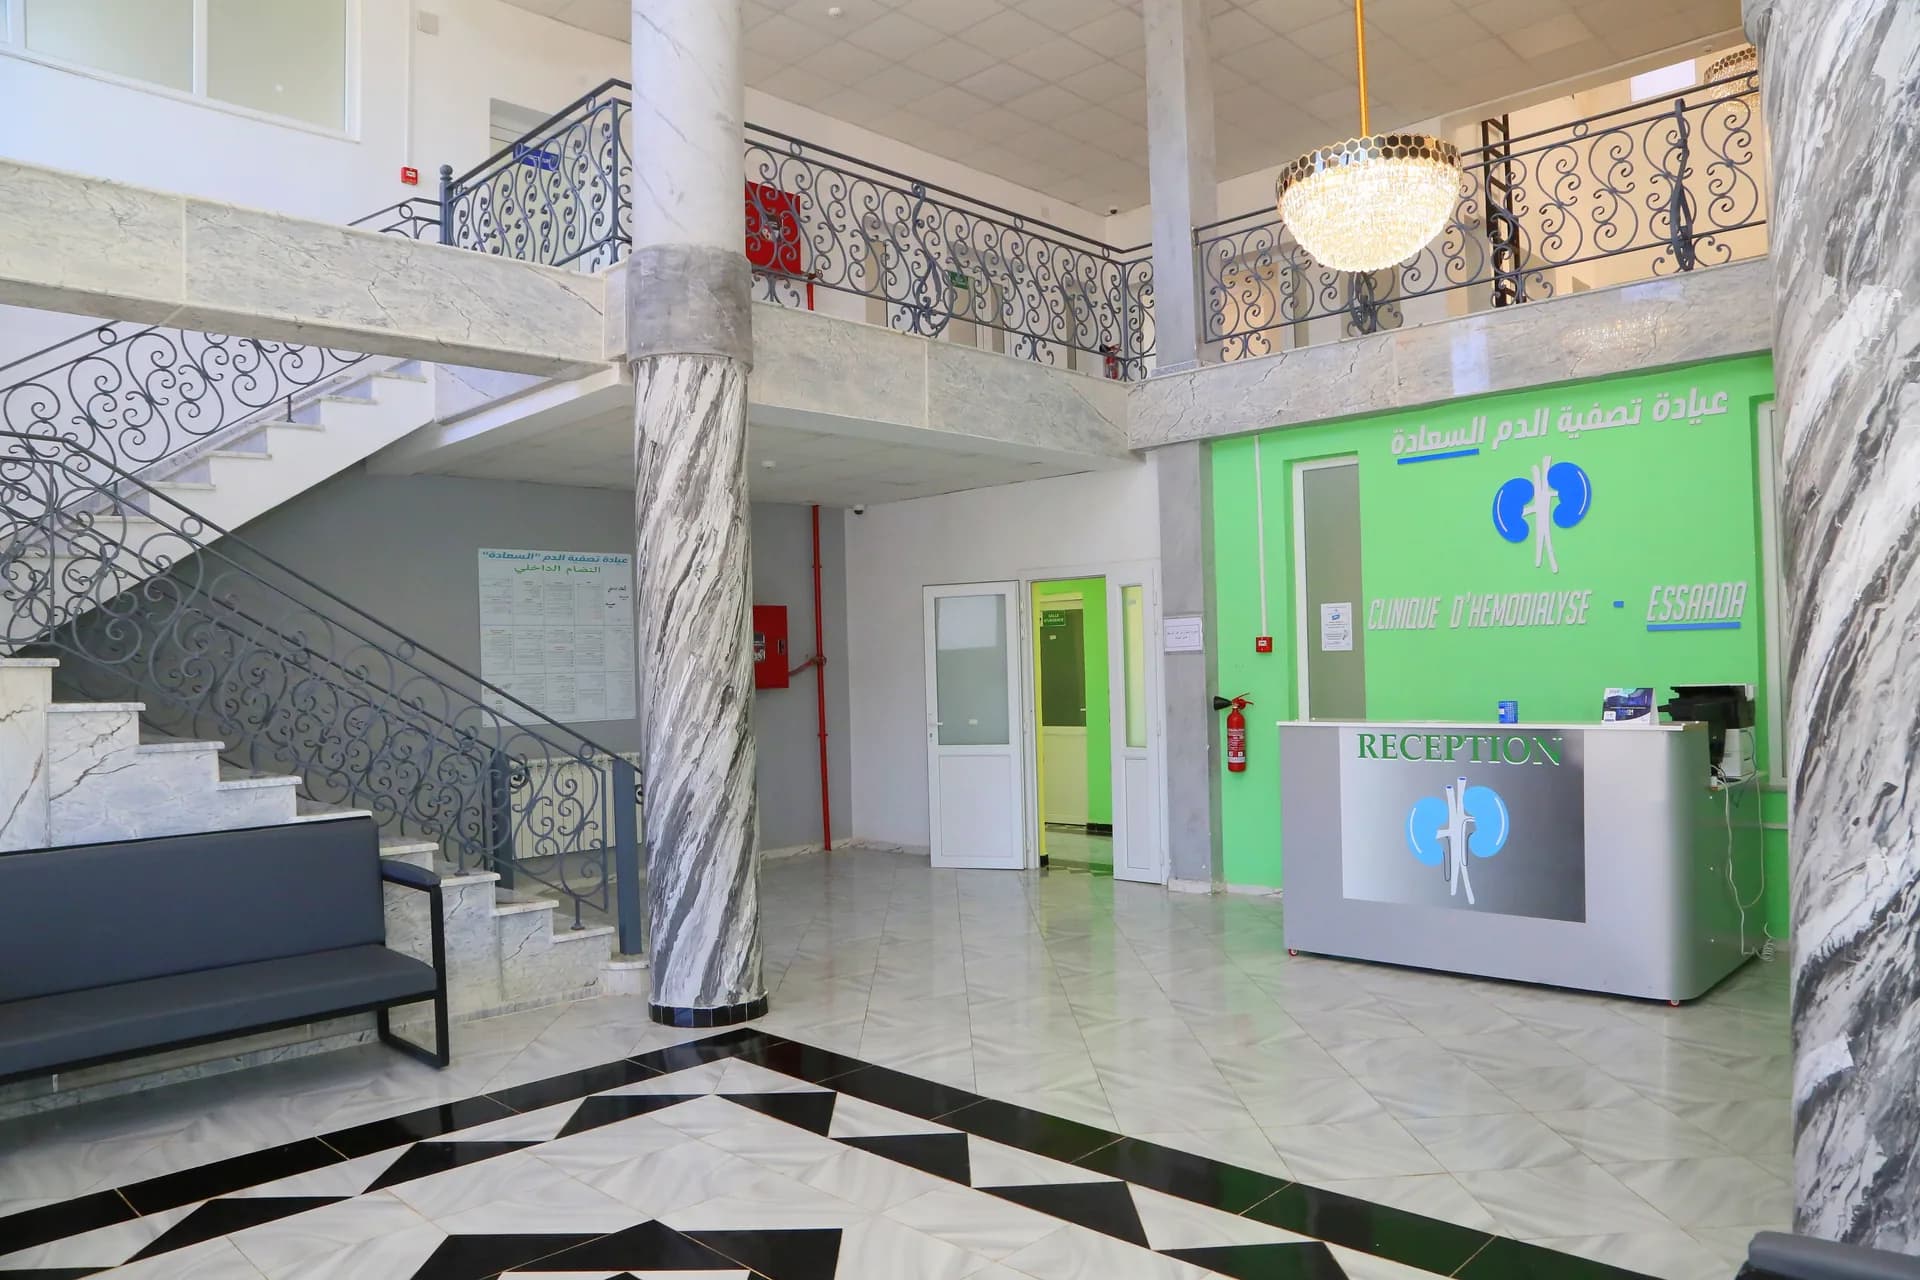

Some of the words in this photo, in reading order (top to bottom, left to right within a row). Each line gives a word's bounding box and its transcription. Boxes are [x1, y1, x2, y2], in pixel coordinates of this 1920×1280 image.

[1557, 398, 1643, 439] تصفية
[1652, 386, 1729, 425] عيادة
[1391, 416, 1487, 455] السعادة
[1491, 408, 1550, 450] الدم
[514, 563, 561, 574] الداخلي
[542, 553, 565, 562] الدم
[567, 554, 600, 563] تصفية
[602, 555, 629, 564] عيادة
[1367, 596, 1441, 630] CLINIQUE
[1448, 590, 1592, 629] D'HEMODIALYSE
[1646, 581, 1748, 621] ESSAADA
[1356, 732, 1563, 767] RECEPTION
